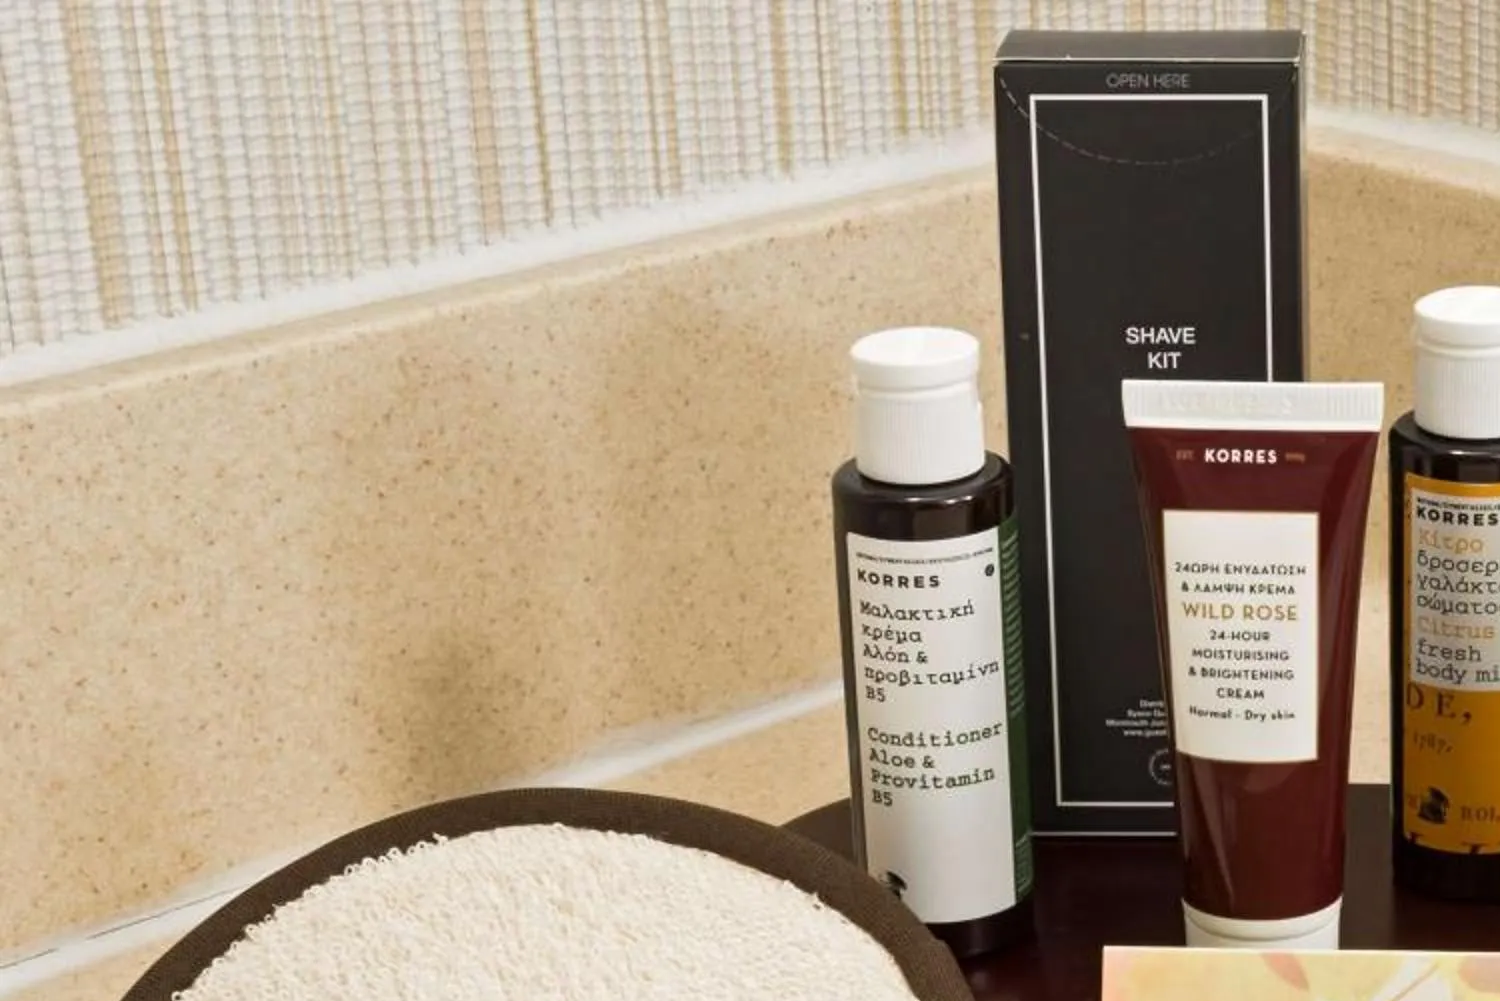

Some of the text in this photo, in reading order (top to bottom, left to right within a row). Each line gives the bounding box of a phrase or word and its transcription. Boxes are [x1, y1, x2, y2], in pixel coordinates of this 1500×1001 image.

[1106, 74, 1190, 88] OPEN HERE
[1126, 328, 1196, 344] SHAVE
[1148, 352, 1181, 368] KIT
[1204, 448, 1278, 464] KORRES
[1417, 505, 1499, 526] KORRES
[857, 568, 940, 588] KORRES
[860, 599, 974, 621] Μαλακτική
[1181, 602, 1298, 621] WILD ROSE
[861, 623, 921, 644] κρέμα
[1417, 616, 1495, 639] Citrus
[863, 644, 928, 664] Αλόη &
[1192, 649, 1290, 661] MOISTURISING
[1417, 638, 1482, 662] fresh
[864, 659, 999, 687] προβιταμίνη
[1200, 668, 1295, 680] BRIGHTENING
[1416, 658, 1467, 684] body
[1216, 688, 1265, 699] CREAM
[1189, 706, 1232, 720] Normal
[1244, 709, 1265, 722] Dry
[867, 721, 1003, 748] Conditioner
[869, 748, 935, 768] Aloe &
[871, 768, 995, 789] Provitamin
[872, 789, 893, 807] B5
